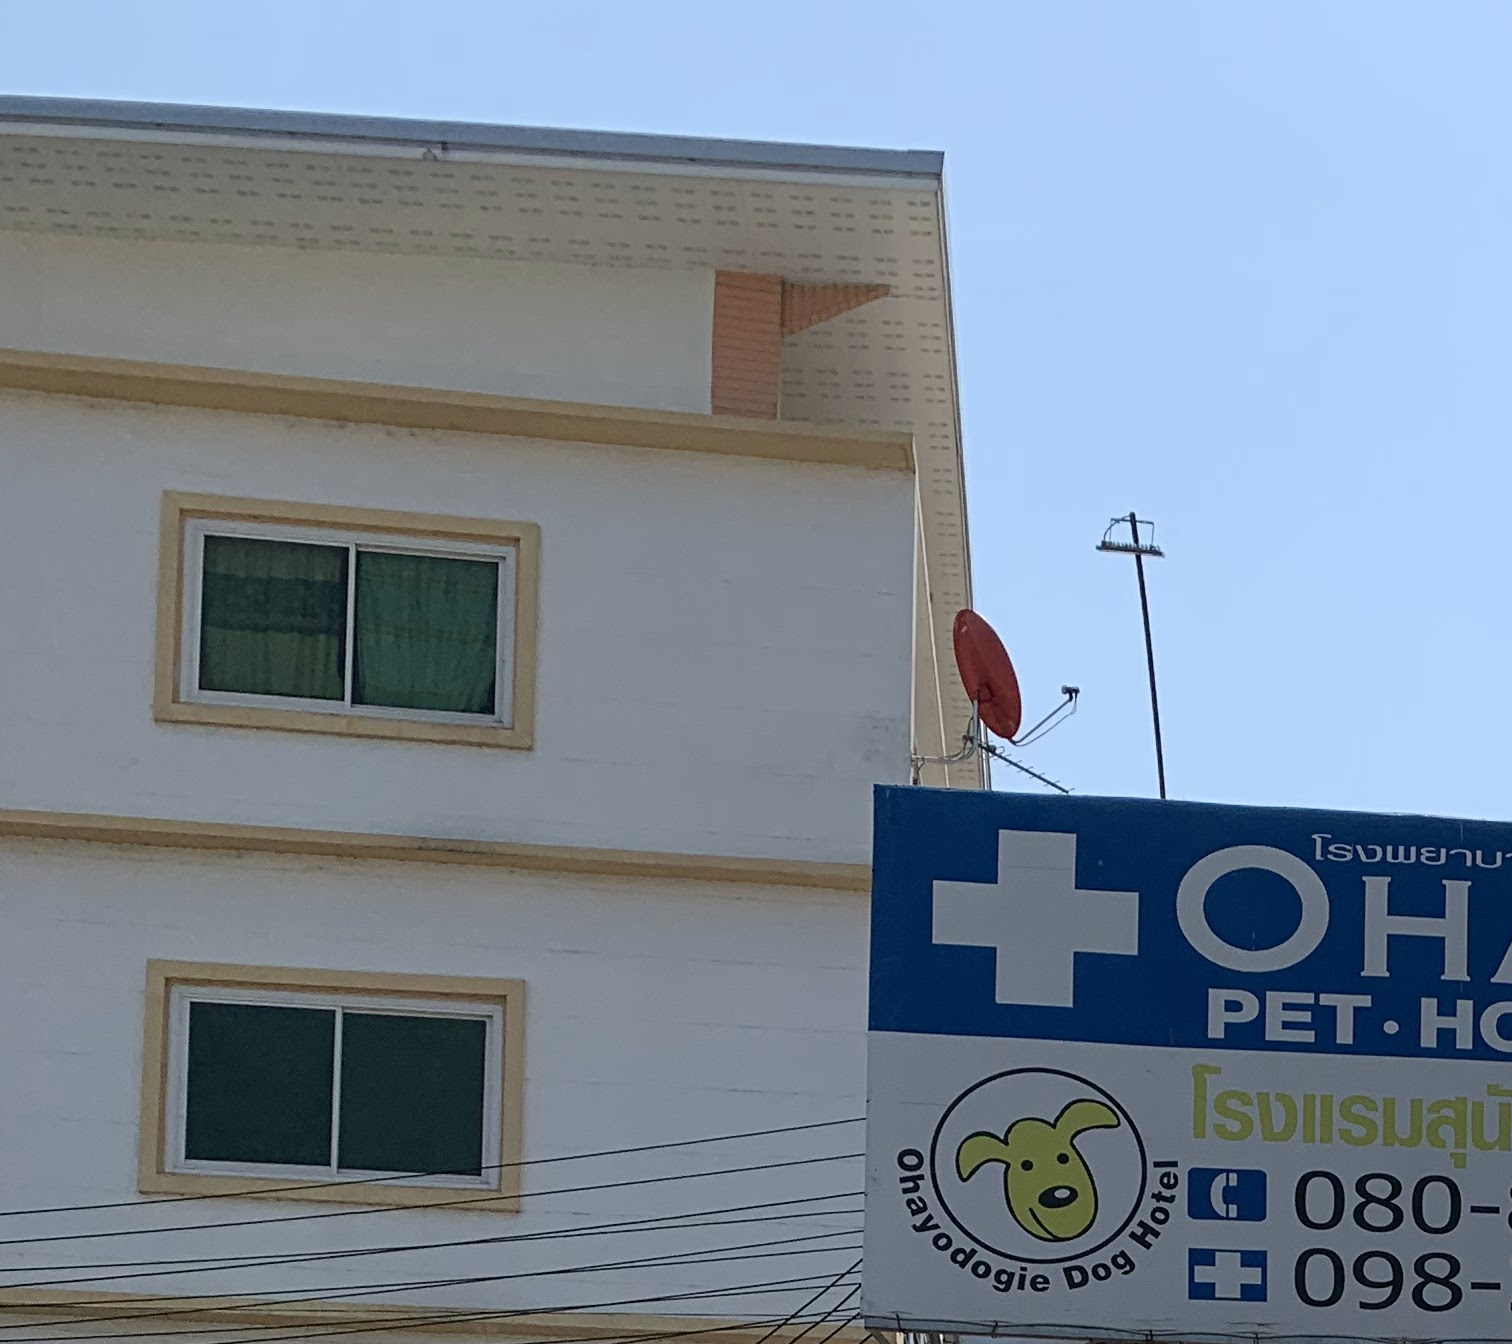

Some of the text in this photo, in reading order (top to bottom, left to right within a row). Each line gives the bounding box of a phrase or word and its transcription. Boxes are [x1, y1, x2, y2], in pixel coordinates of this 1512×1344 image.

[897, 1148, 1179, 1293] Ohayodogie Dog Hotel
